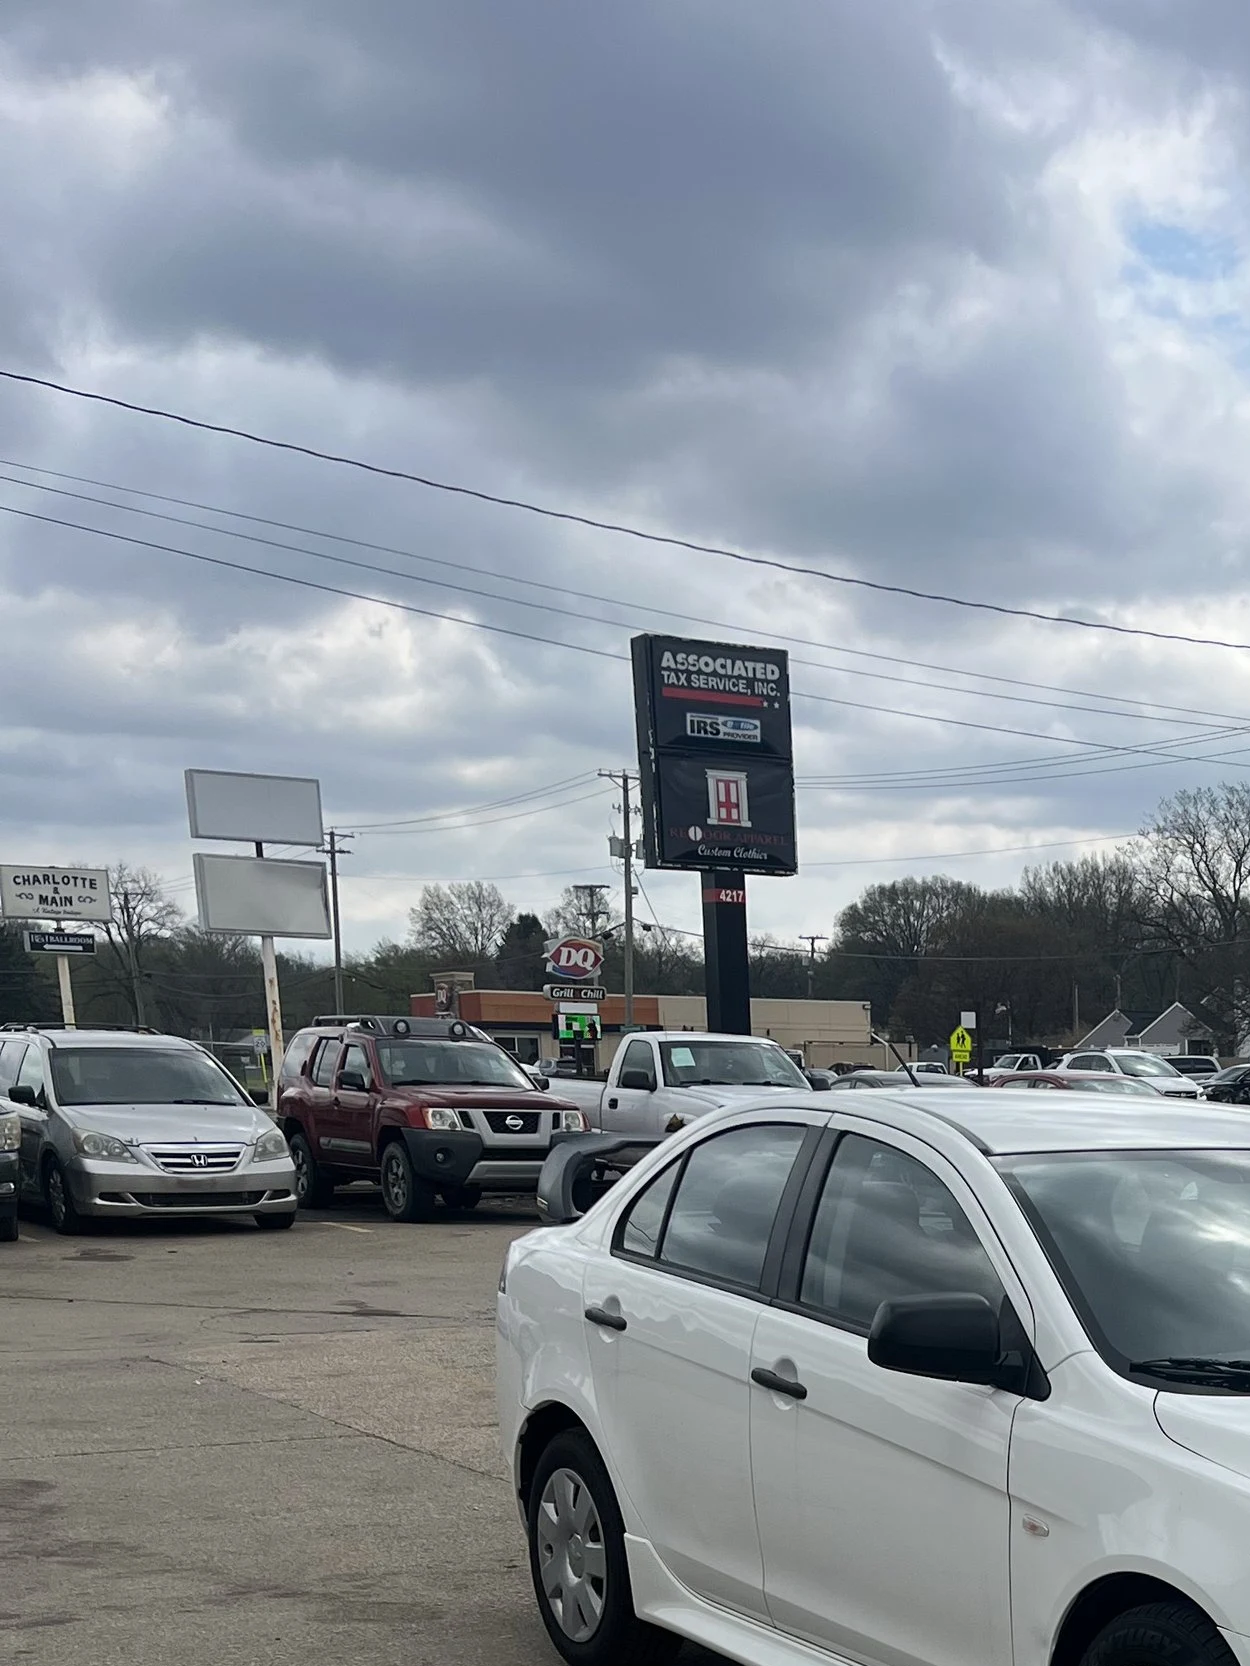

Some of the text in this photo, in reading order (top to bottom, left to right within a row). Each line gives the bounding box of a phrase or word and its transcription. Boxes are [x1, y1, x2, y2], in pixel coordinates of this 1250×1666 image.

[661, 651, 780, 680] ASSOCIATED
[661, 670, 780, 696] TAX SERVICE, INC.
[690, 719, 721, 736] IRS
[723, 731, 758, 741] PROVIDER
[697, 843, 768, 860] Custom Clothier
[13, 874, 97, 890] CHARLOTTE
[52, 886, 60, 895] &
[719, 889, 744, 902] 4217
[39, 894, 73, 907] MAIN
[558, 946, 595, 971] DQ
[552, 988, 604, 999] Grill Chill
